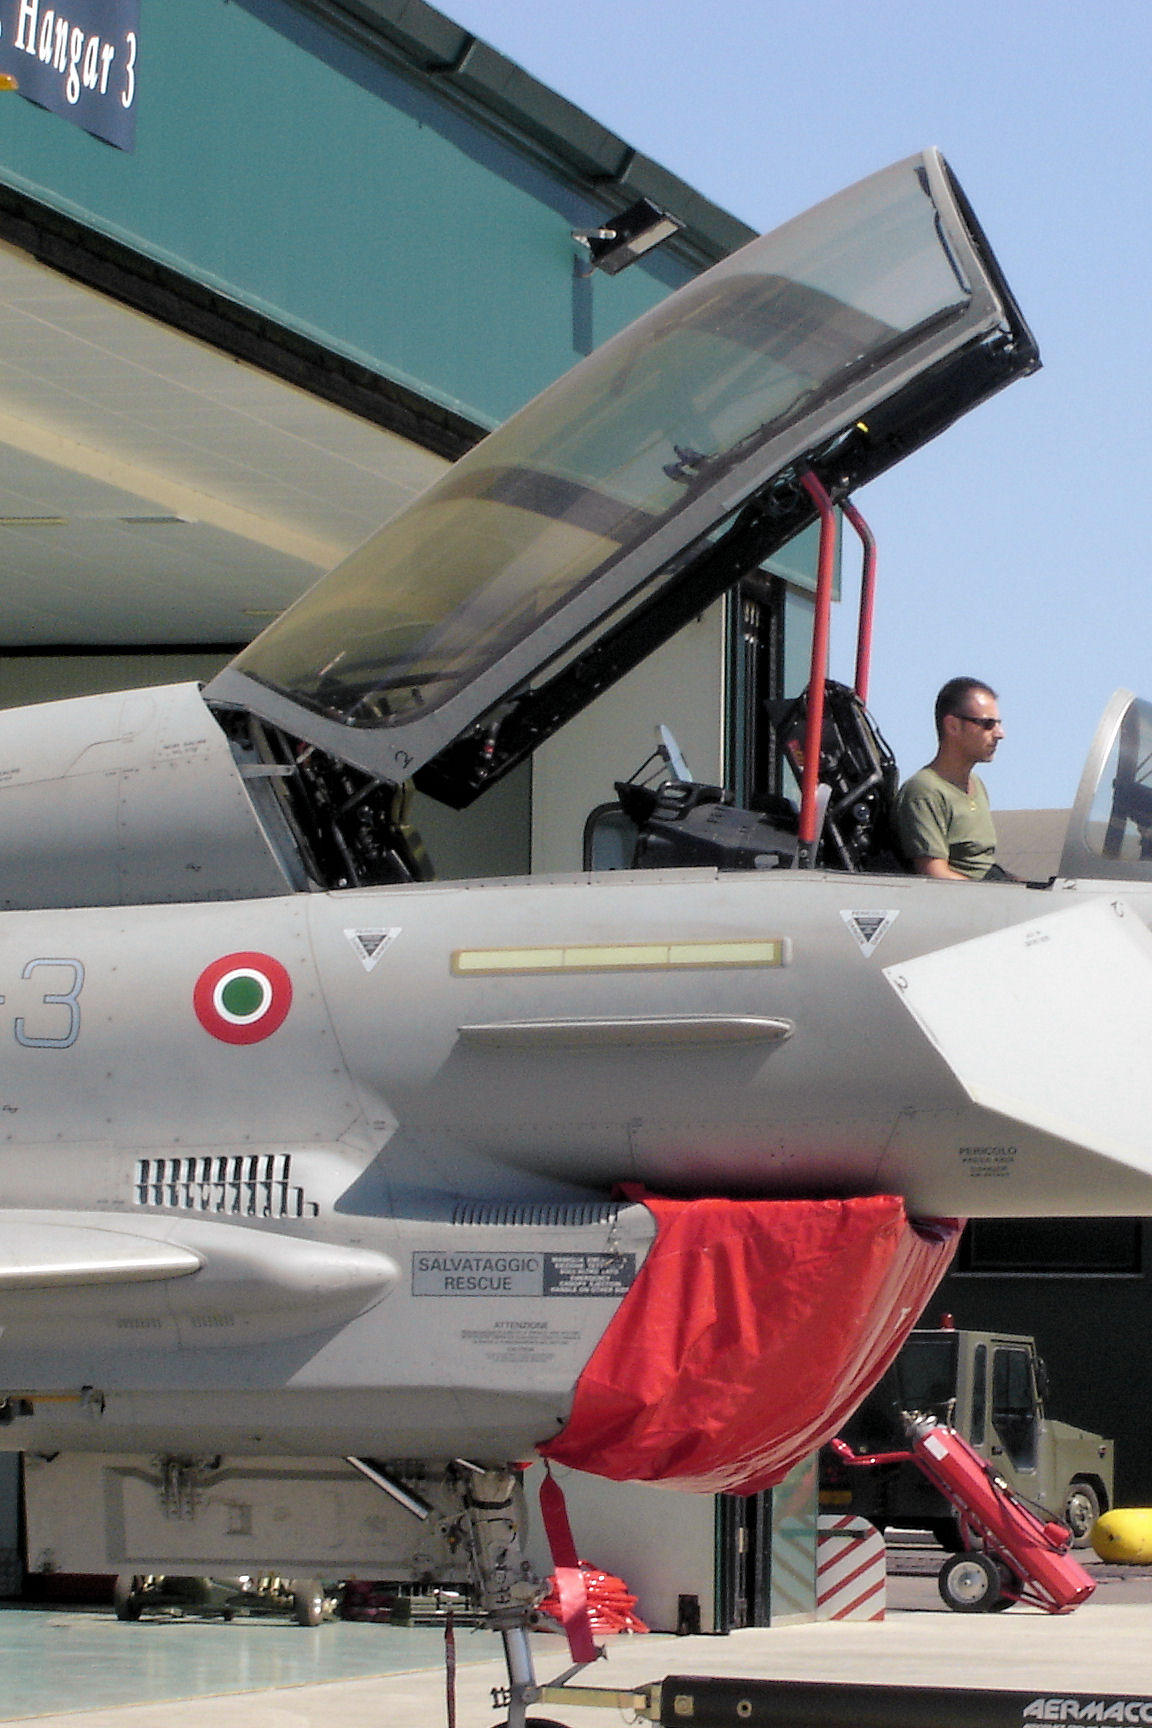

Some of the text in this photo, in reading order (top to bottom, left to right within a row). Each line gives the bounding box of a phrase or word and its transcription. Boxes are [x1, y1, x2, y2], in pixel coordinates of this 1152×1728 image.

[14, 0, 138, 109] Hangar 3
[418, 1257, 539, 1272] SALVATAGGIO
[444, 1276, 512, 1291] RESCUE
